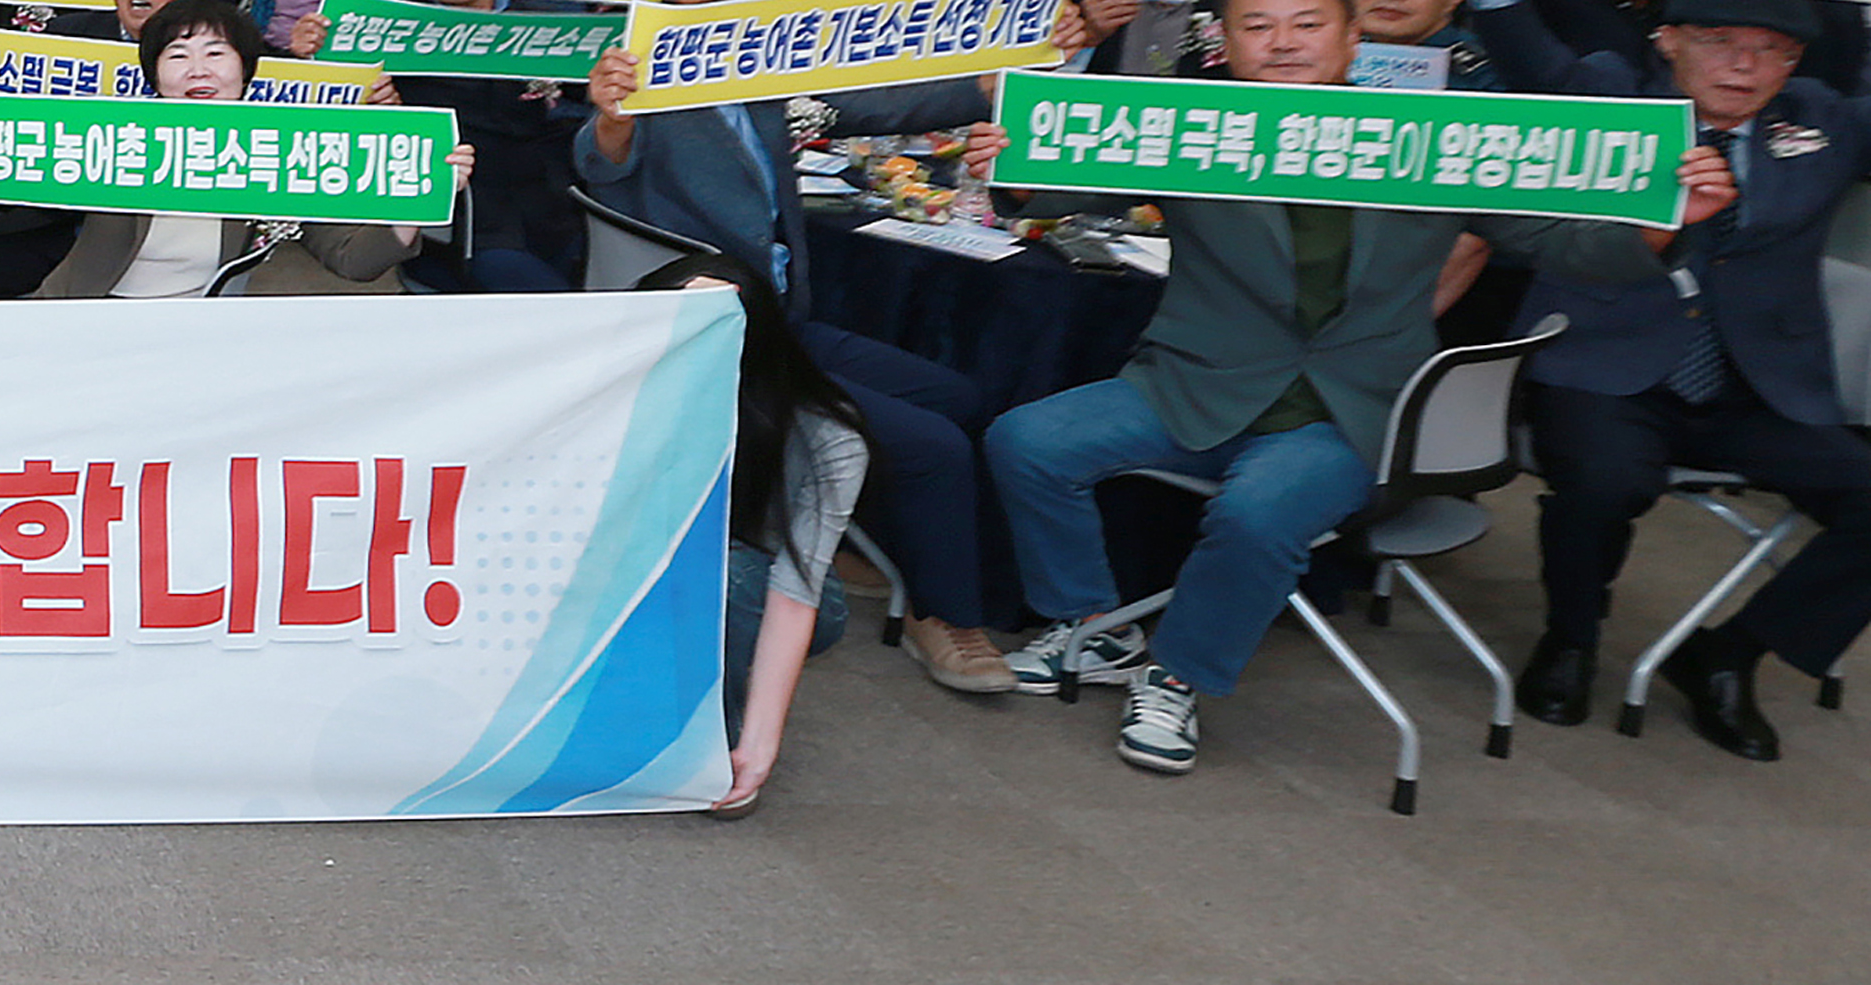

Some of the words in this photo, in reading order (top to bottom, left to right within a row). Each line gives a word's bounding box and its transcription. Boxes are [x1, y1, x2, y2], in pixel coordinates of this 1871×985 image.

[330, 13, 420, 54] 함평군
[420, 19, 502, 55] 농어촌
[494, 26, 615, 60] 기본소득
[647, 18, 739, 89] 함평군
[737, 9, 824, 77] 농어촌
[52, 121, 147, 186] 농어촌
[153, 126, 280, 192] 기본소득
[286, 131, 350, 193] 선정
[357, 132, 433, 196] 기원!
[1027, 97, 1177, 168] 인구소멸
[1178, 107, 1265, 182] 극복,
[1272, 112, 1433, 182] 함평군이
[1433, 120, 1658, 194] 앞장섭니다!
